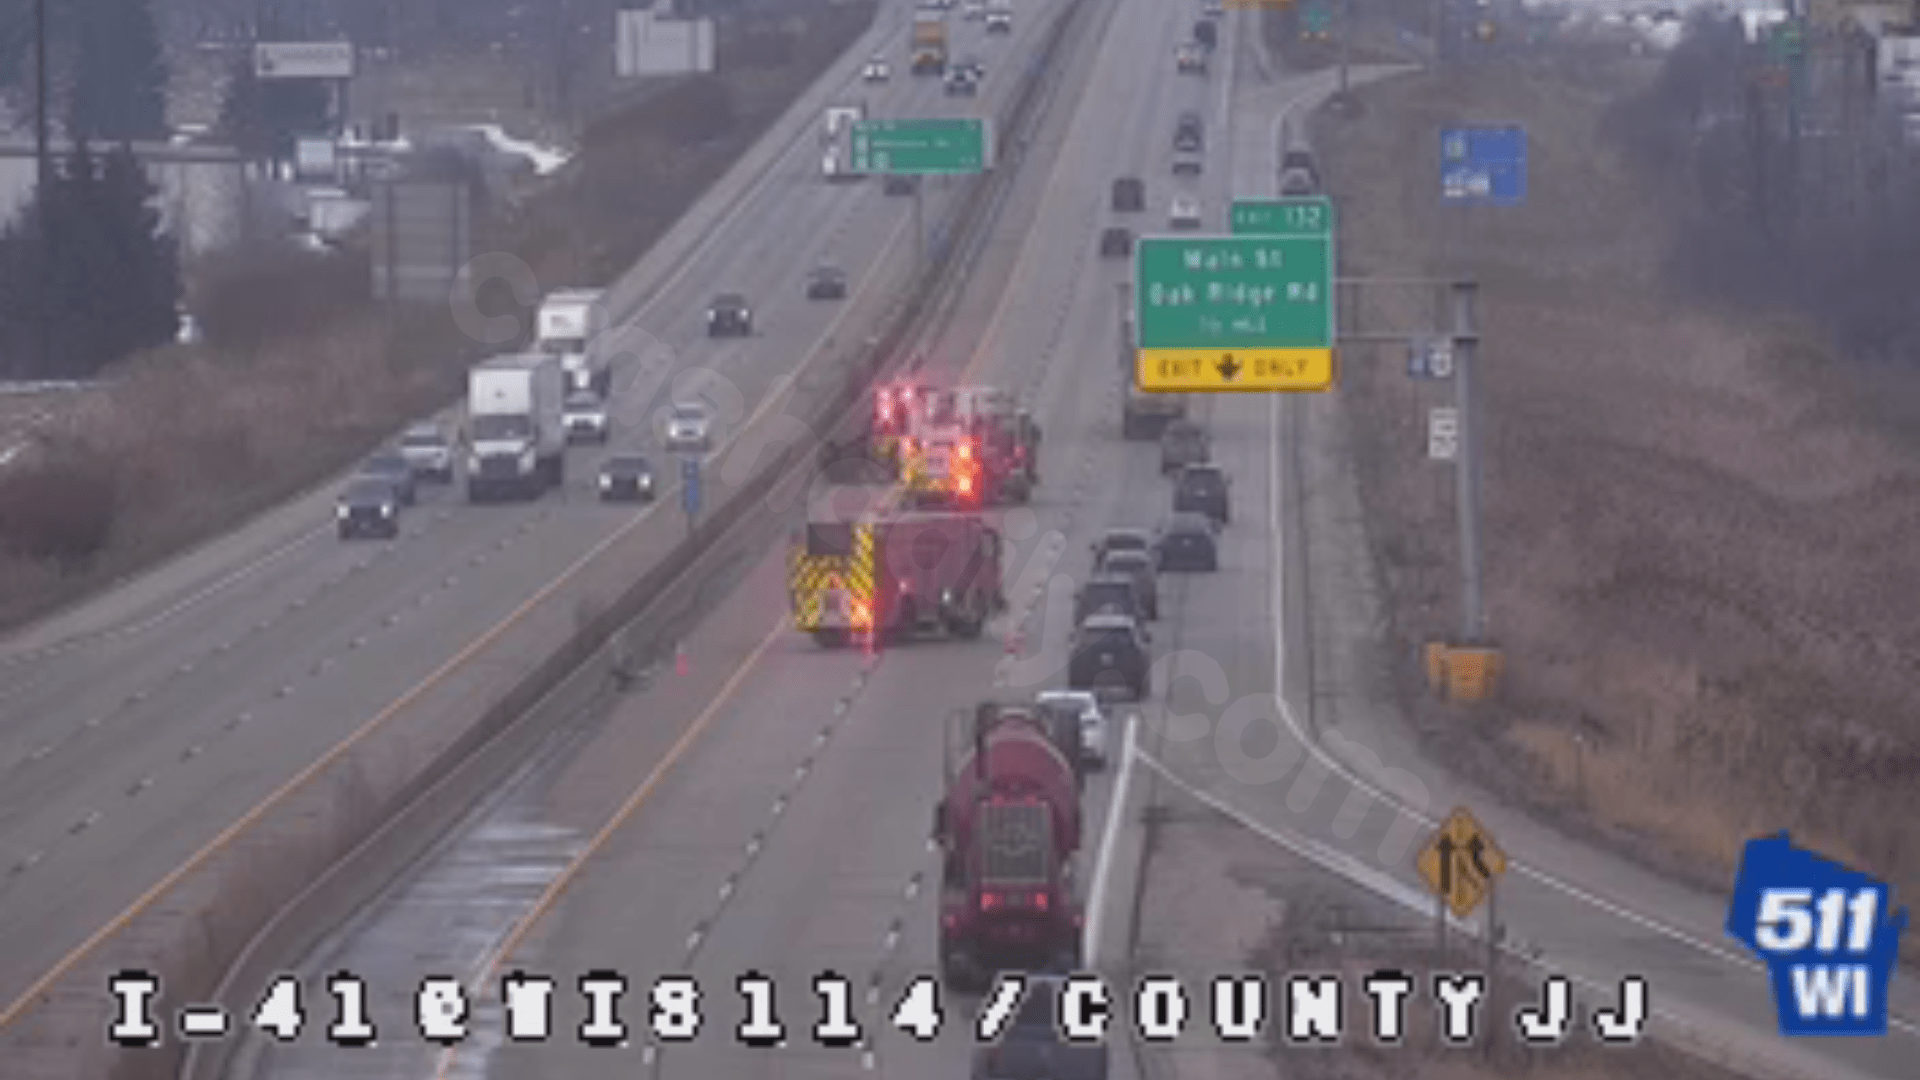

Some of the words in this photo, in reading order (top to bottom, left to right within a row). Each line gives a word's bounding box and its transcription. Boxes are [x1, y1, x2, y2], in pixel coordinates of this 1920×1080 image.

[1184, 249, 1244, 269] Main
[1255, 248, 1283, 268] St
[1150, 282, 1195, 304] Oak
[1207, 282, 1276, 307] Ridge
[1287, 281, 1318, 303] Rd
[1157, 358, 1202, 377] EXIT
[1254, 358, 1308, 377] ONLY
